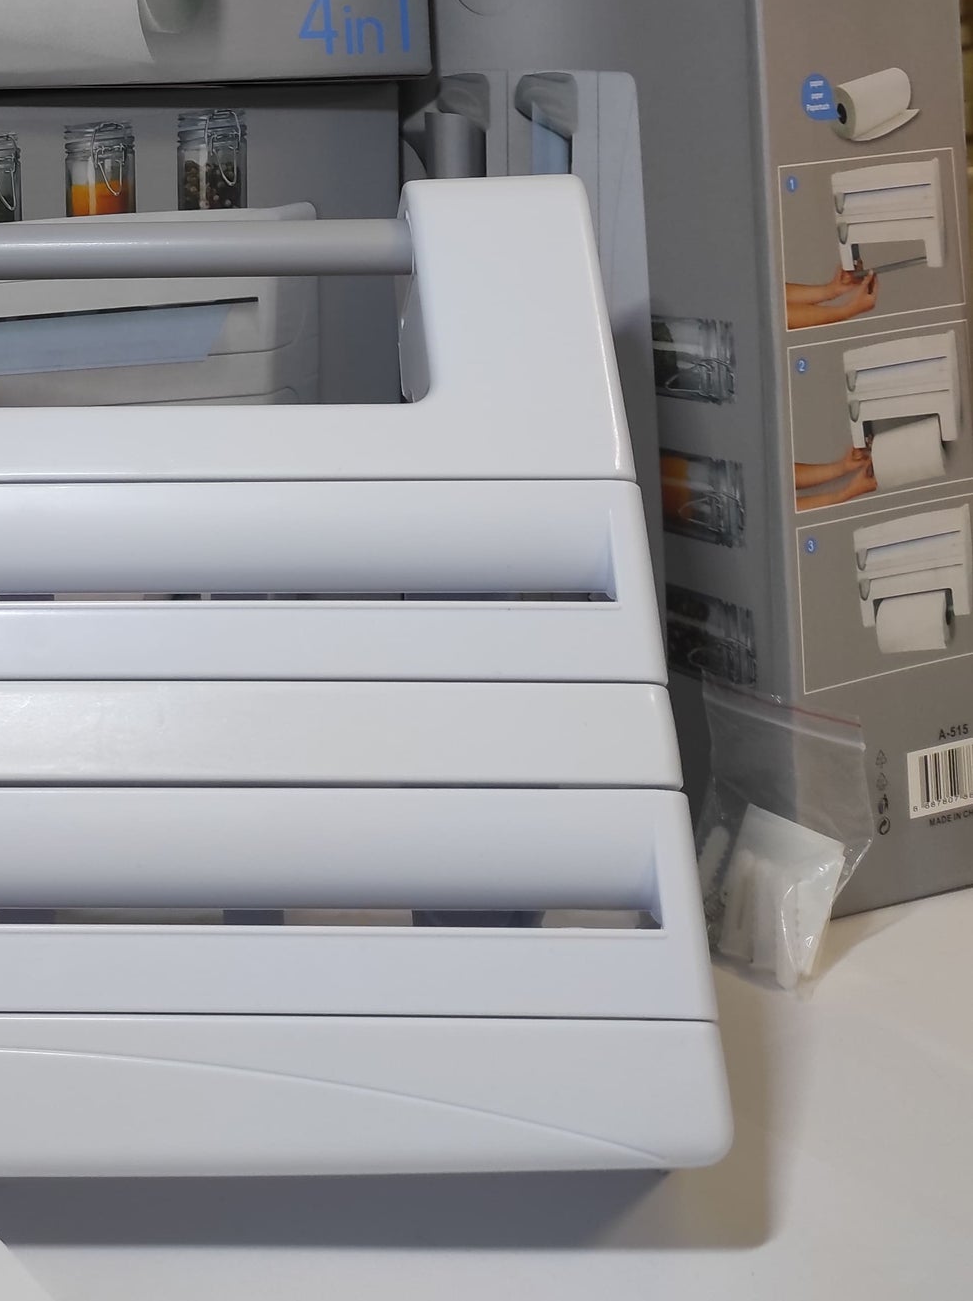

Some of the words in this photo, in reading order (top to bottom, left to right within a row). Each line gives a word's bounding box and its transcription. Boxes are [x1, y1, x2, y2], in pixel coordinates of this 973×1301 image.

[798, 360, 805, 372] 2
[807, 540, 814, 552] 3
[938, 723, 969, 740] A-515
[929, 814, 952, 826] MADE
[954, 812, 962, 821] IN
